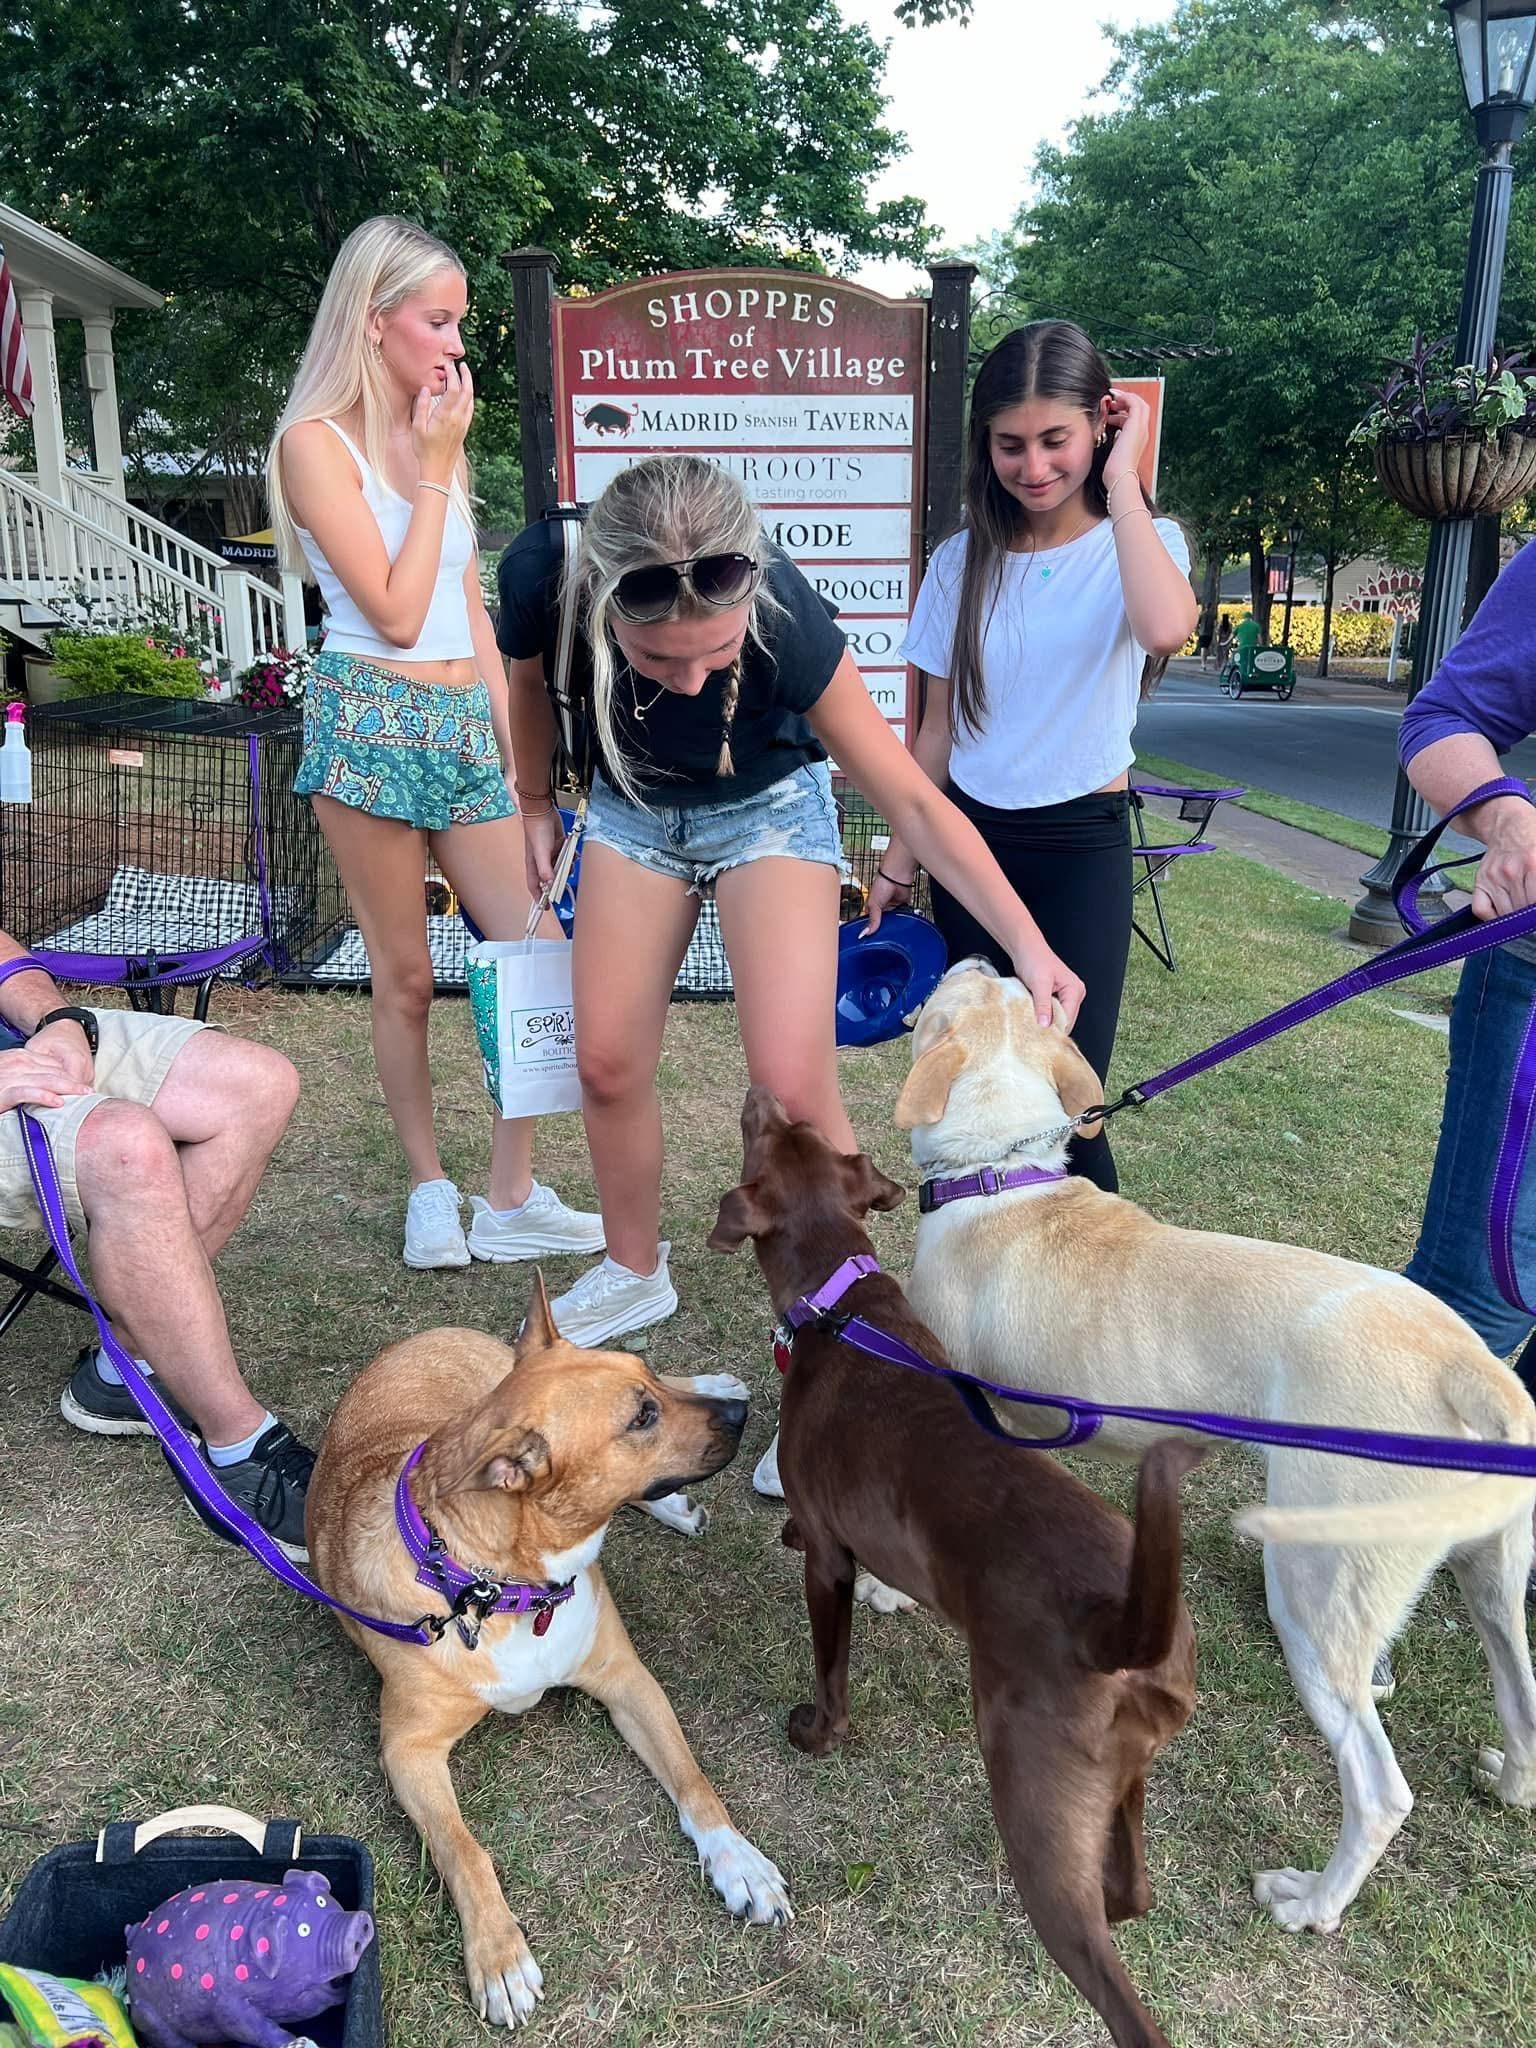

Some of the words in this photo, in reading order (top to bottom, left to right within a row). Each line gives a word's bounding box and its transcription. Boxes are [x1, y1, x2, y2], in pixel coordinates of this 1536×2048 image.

[647, 288, 836, 328] SHOPPES
[729, 325, 755, 348] of
[579, 348, 677, 380] Plum
[685, 348, 769, 380] Tree
[776, 346, 905, 386] Village
[641, 409, 738, 432] MADRID
[744, 413, 798, 429] SPANISH
[803, 409, 909, 432] TAVERNA
[742, 456, 863, 481] ROOTS
[755, 486, 806, 501] tasting
[809, 488, 847, 499] room
[221, 544, 277, 558] MADRID
[815, 578, 904, 601] POOCH
